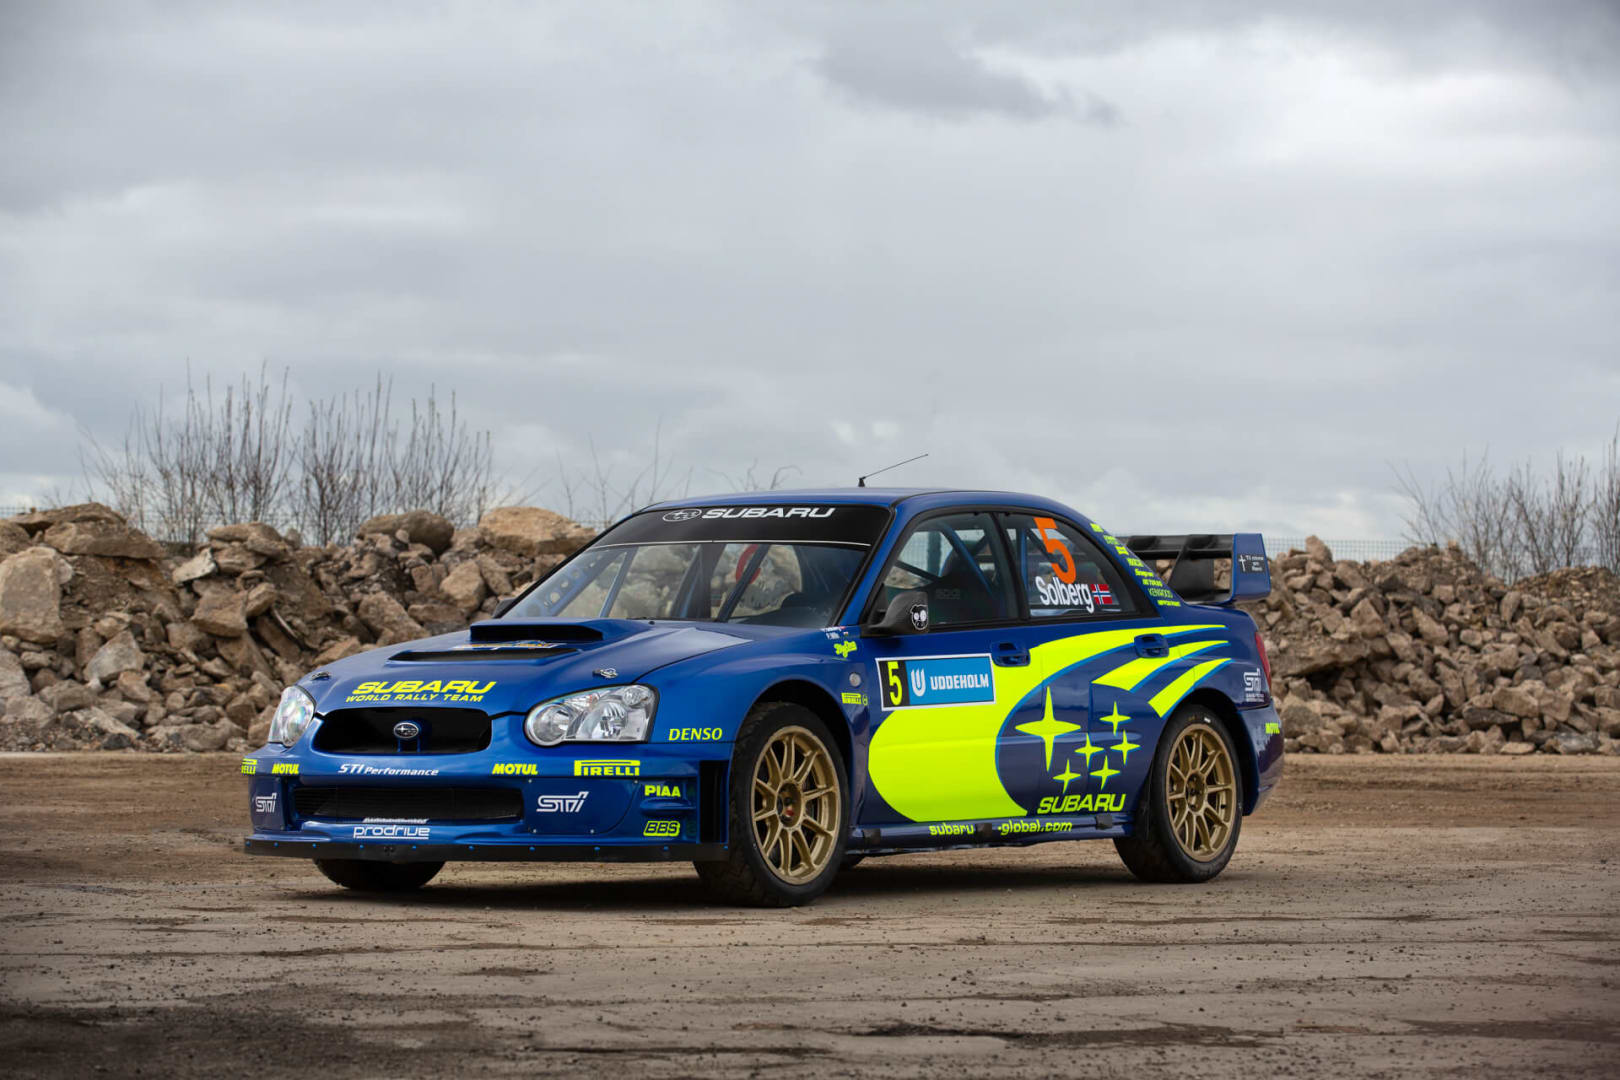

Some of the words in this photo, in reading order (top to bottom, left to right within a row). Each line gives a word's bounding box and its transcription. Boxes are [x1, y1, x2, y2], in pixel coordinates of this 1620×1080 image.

[702, 508, 836, 519] SUBARU
[1033, 517, 1076, 584] 5
[1035, 576, 1095, 613] Solberg
[352, 681, 496, 694] SUBARU
[887, 661, 903, 705] 5
[930, 674, 990, 690] UDDEHOLM
[346, 694, 391, 702] WORLD
[395, 694, 438, 702] RALLY
[443, 694, 484, 702] TEAM
[669, 728, 723, 741] DENSO
[271, 763, 299, 774] MOTUL
[338, 763, 365, 774] STI
[364, 766, 440, 776] Performance
[492, 763, 538, 775] MOTUL
[574, 760, 641, 776] PIRELLI
[645, 785, 681, 797] PIAA
[1037, 794, 1126, 814] SUBARU
[353, 825, 430, 839] prodrive
[644, 821, 680, 836] BBS
[929, 823, 975, 836] subaru
